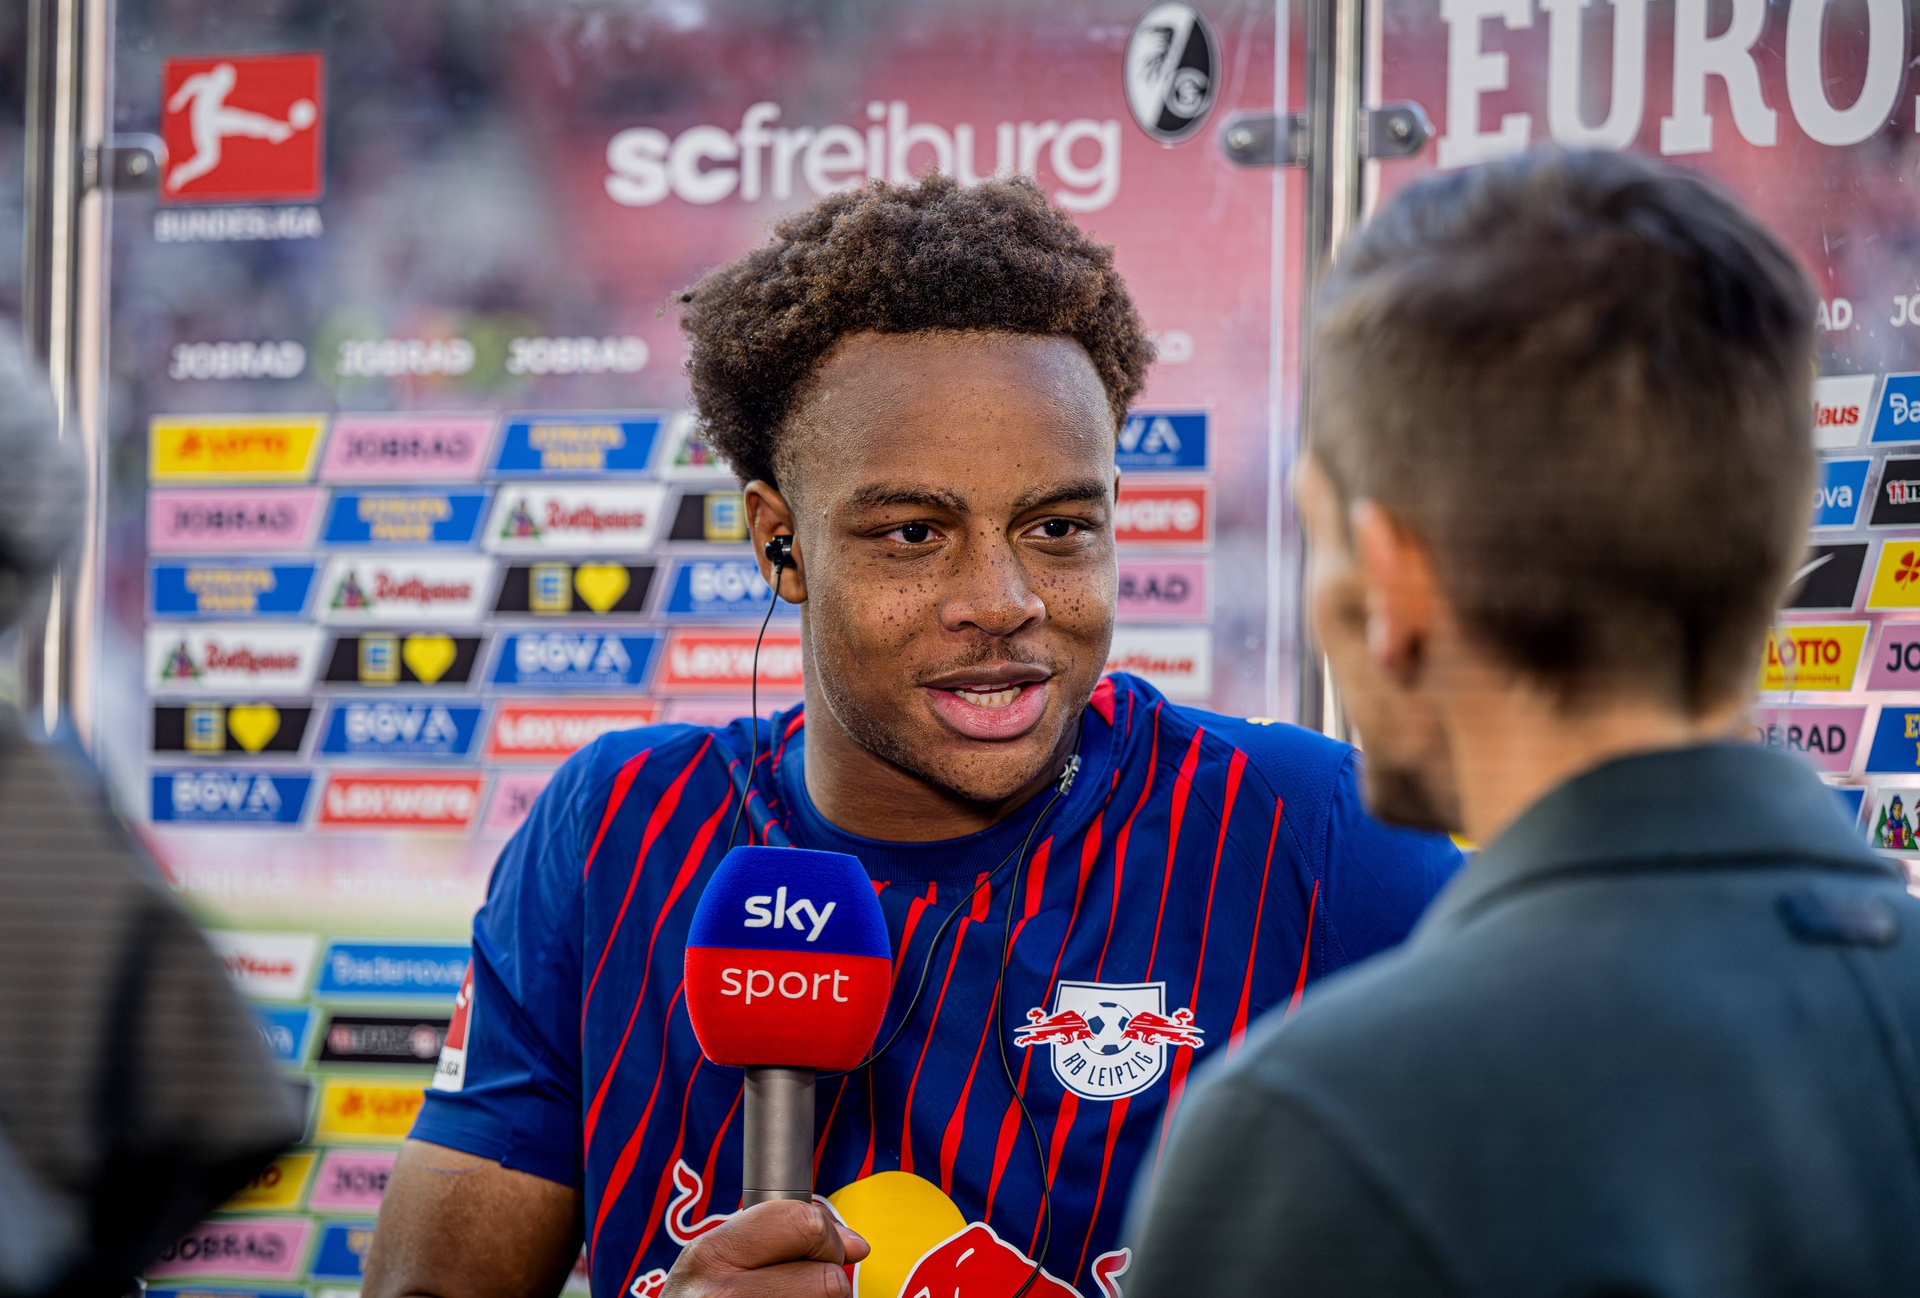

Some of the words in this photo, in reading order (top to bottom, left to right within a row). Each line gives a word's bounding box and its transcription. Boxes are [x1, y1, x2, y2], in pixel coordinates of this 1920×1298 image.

[1438, 0, 1920, 168] EURO
[155, 207, 323, 241] BUNDESLIGA
[1890, 293, 1920, 328] JO
[170, 342, 307, 379] JOBRAD
[338, 339, 476, 375] JOBRAD
[507, 337, 649, 372] JOBRAD
[1889, 393, 1920, 425] Ba
[346, 434, 469, 463] JOBRAD
[172, 506, 297, 535] JOBRAD
[1116, 498, 1200, 532] ware
[1119, 573, 1191, 600] RAD
[1768, 638, 1841, 667] LOTTO
[1886, 641, 1920, 673] JO
[1760, 724, 1847, 754] BRAD
[326, 784, 477, 818] Lexware
[744, 886, 836, 942] sky
[720, 968, 849, 1004] sport
[436, 1060, 459, 1077] LIGA
[1063, 1052, 1087, 1076] RB
[1087, 1051, 1153, 1087] LEIPZIG
